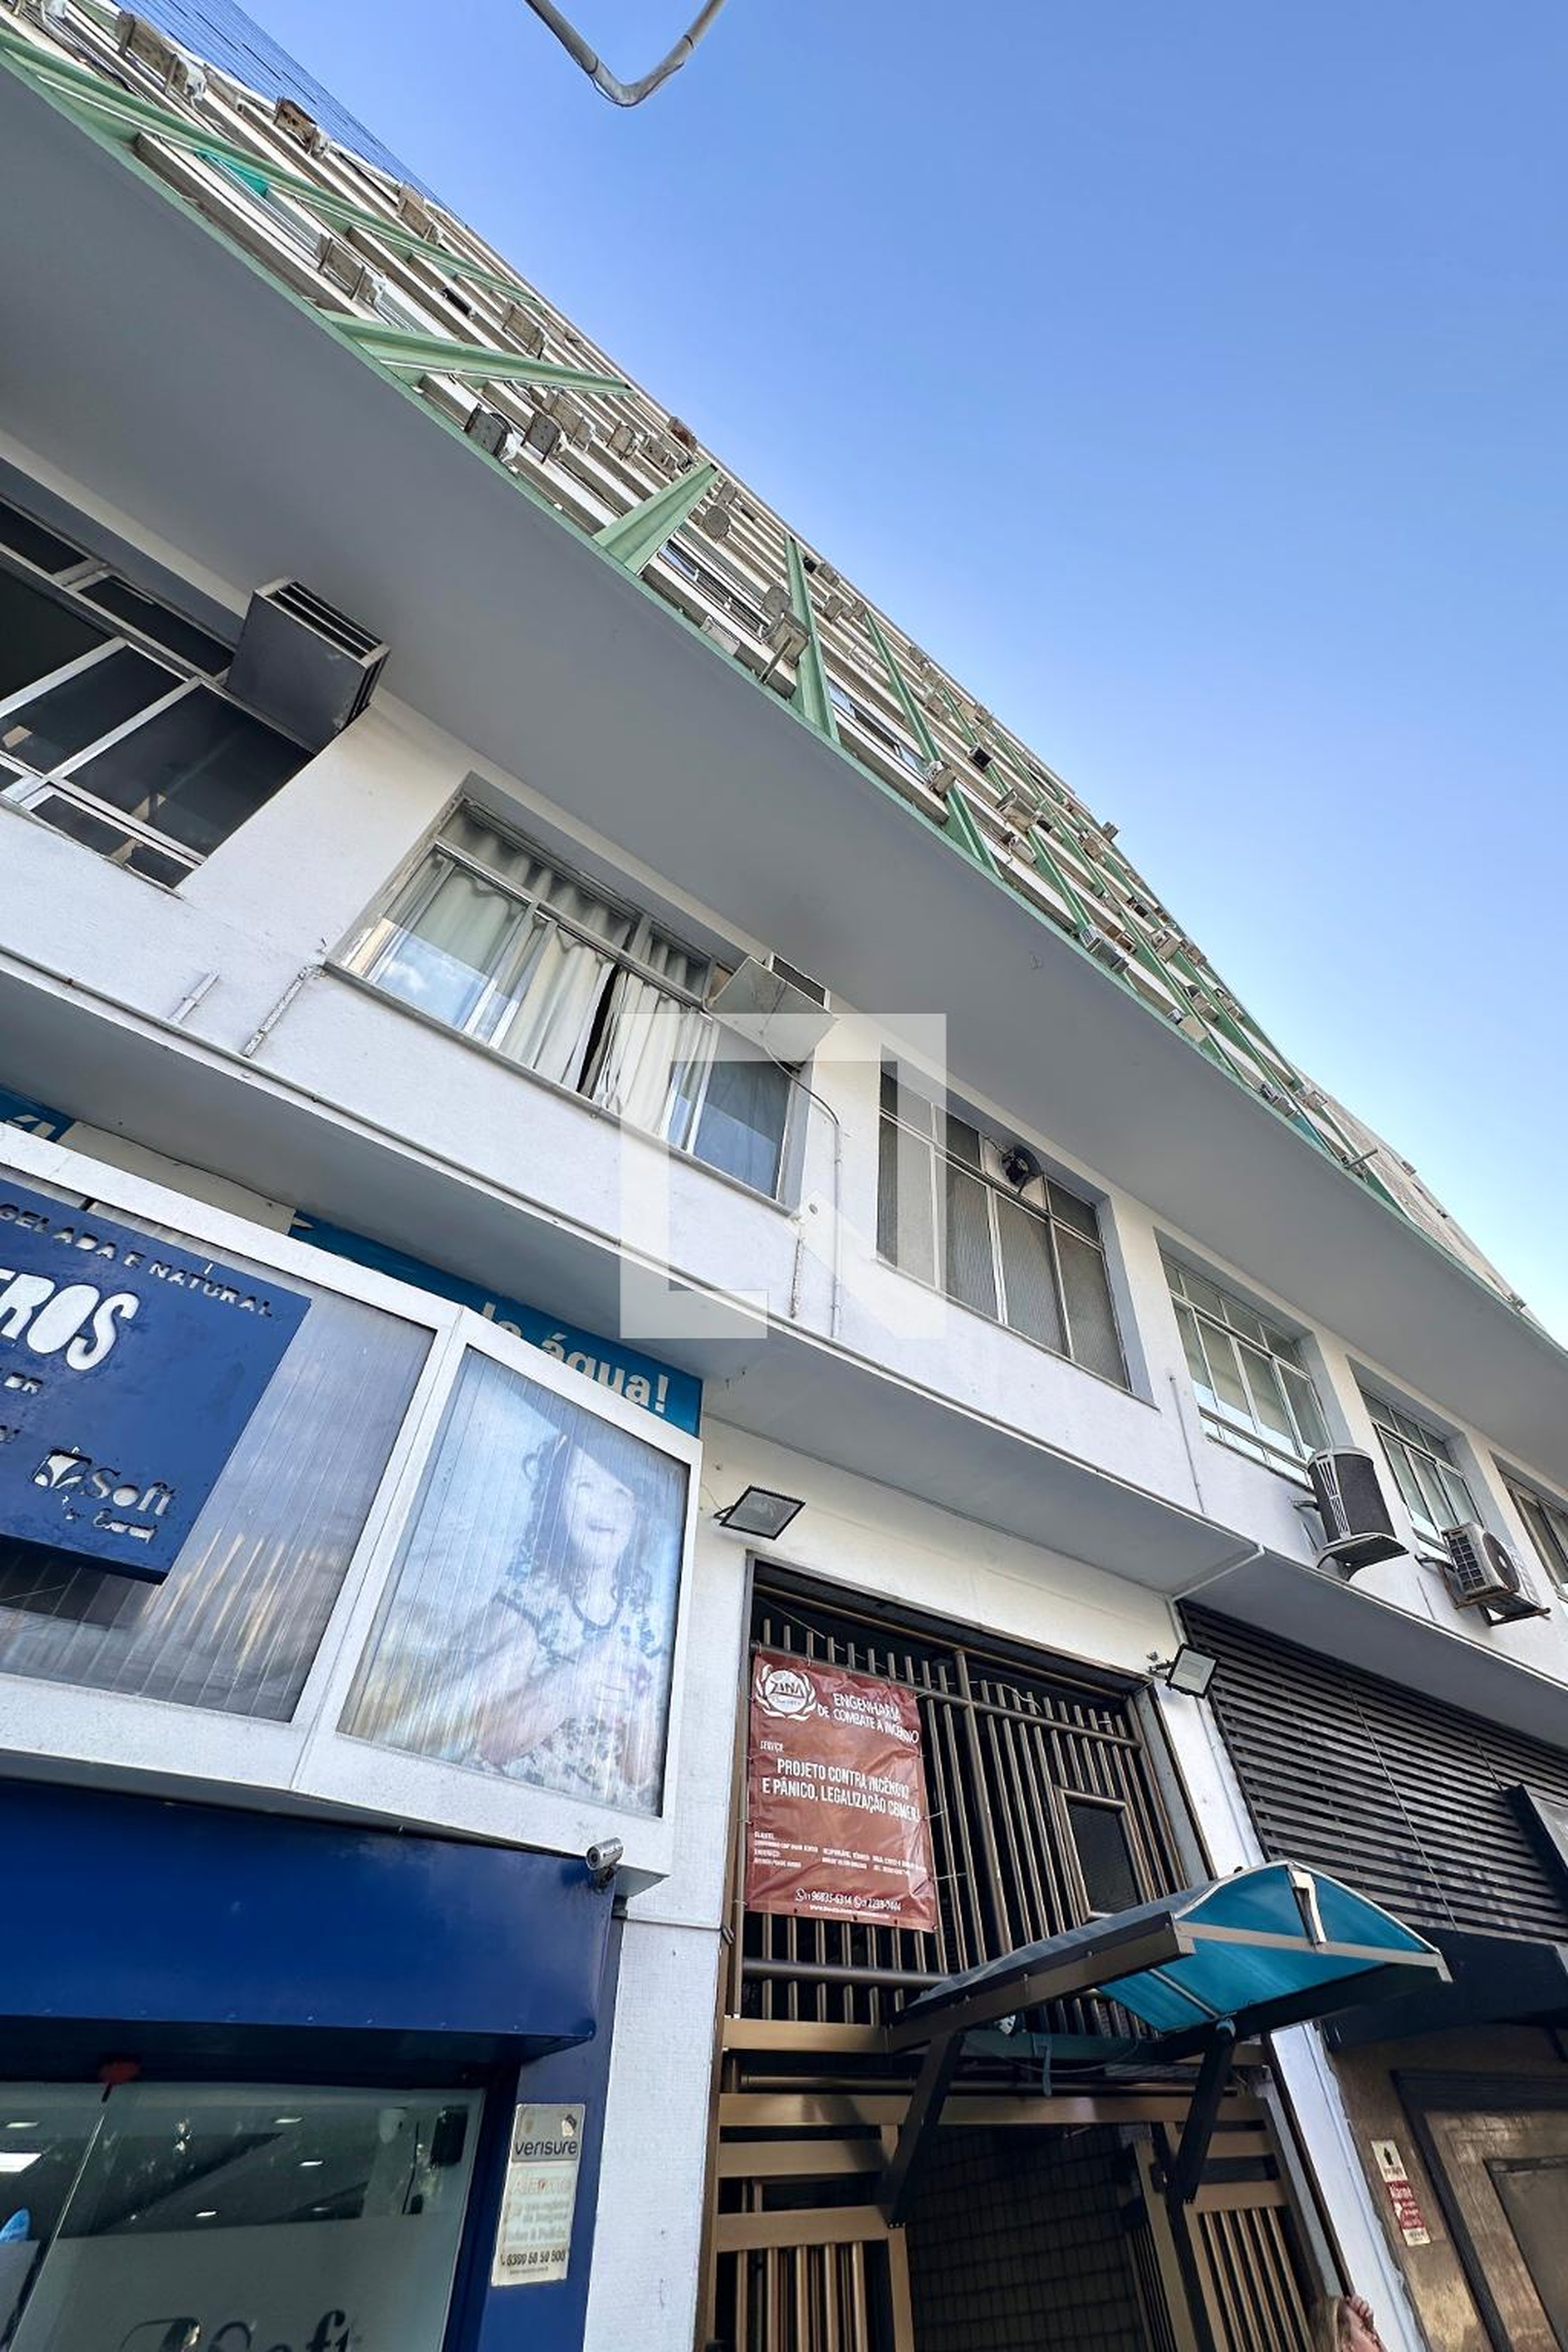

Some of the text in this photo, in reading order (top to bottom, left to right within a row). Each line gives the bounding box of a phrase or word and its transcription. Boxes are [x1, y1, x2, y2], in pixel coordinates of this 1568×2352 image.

[149, 1260, 272, 1317] NATURAL
[817, 1704, 830, 1717] DE
[833, 1708, 877, 1729] COMBATE
[877, 1718, 884, 1733] A
[833, 1693, 901, 1720] ENGENHARIA
[777, 1759, 826, 1780] PROJETO
[828, 1766, 865, 1788] CONTRA
[762, 1777, 770, 1793] E
[821, 1785, 885, 1814] LEGALIZAÇÃO
[515, 2140, 577, 2156] verisure
